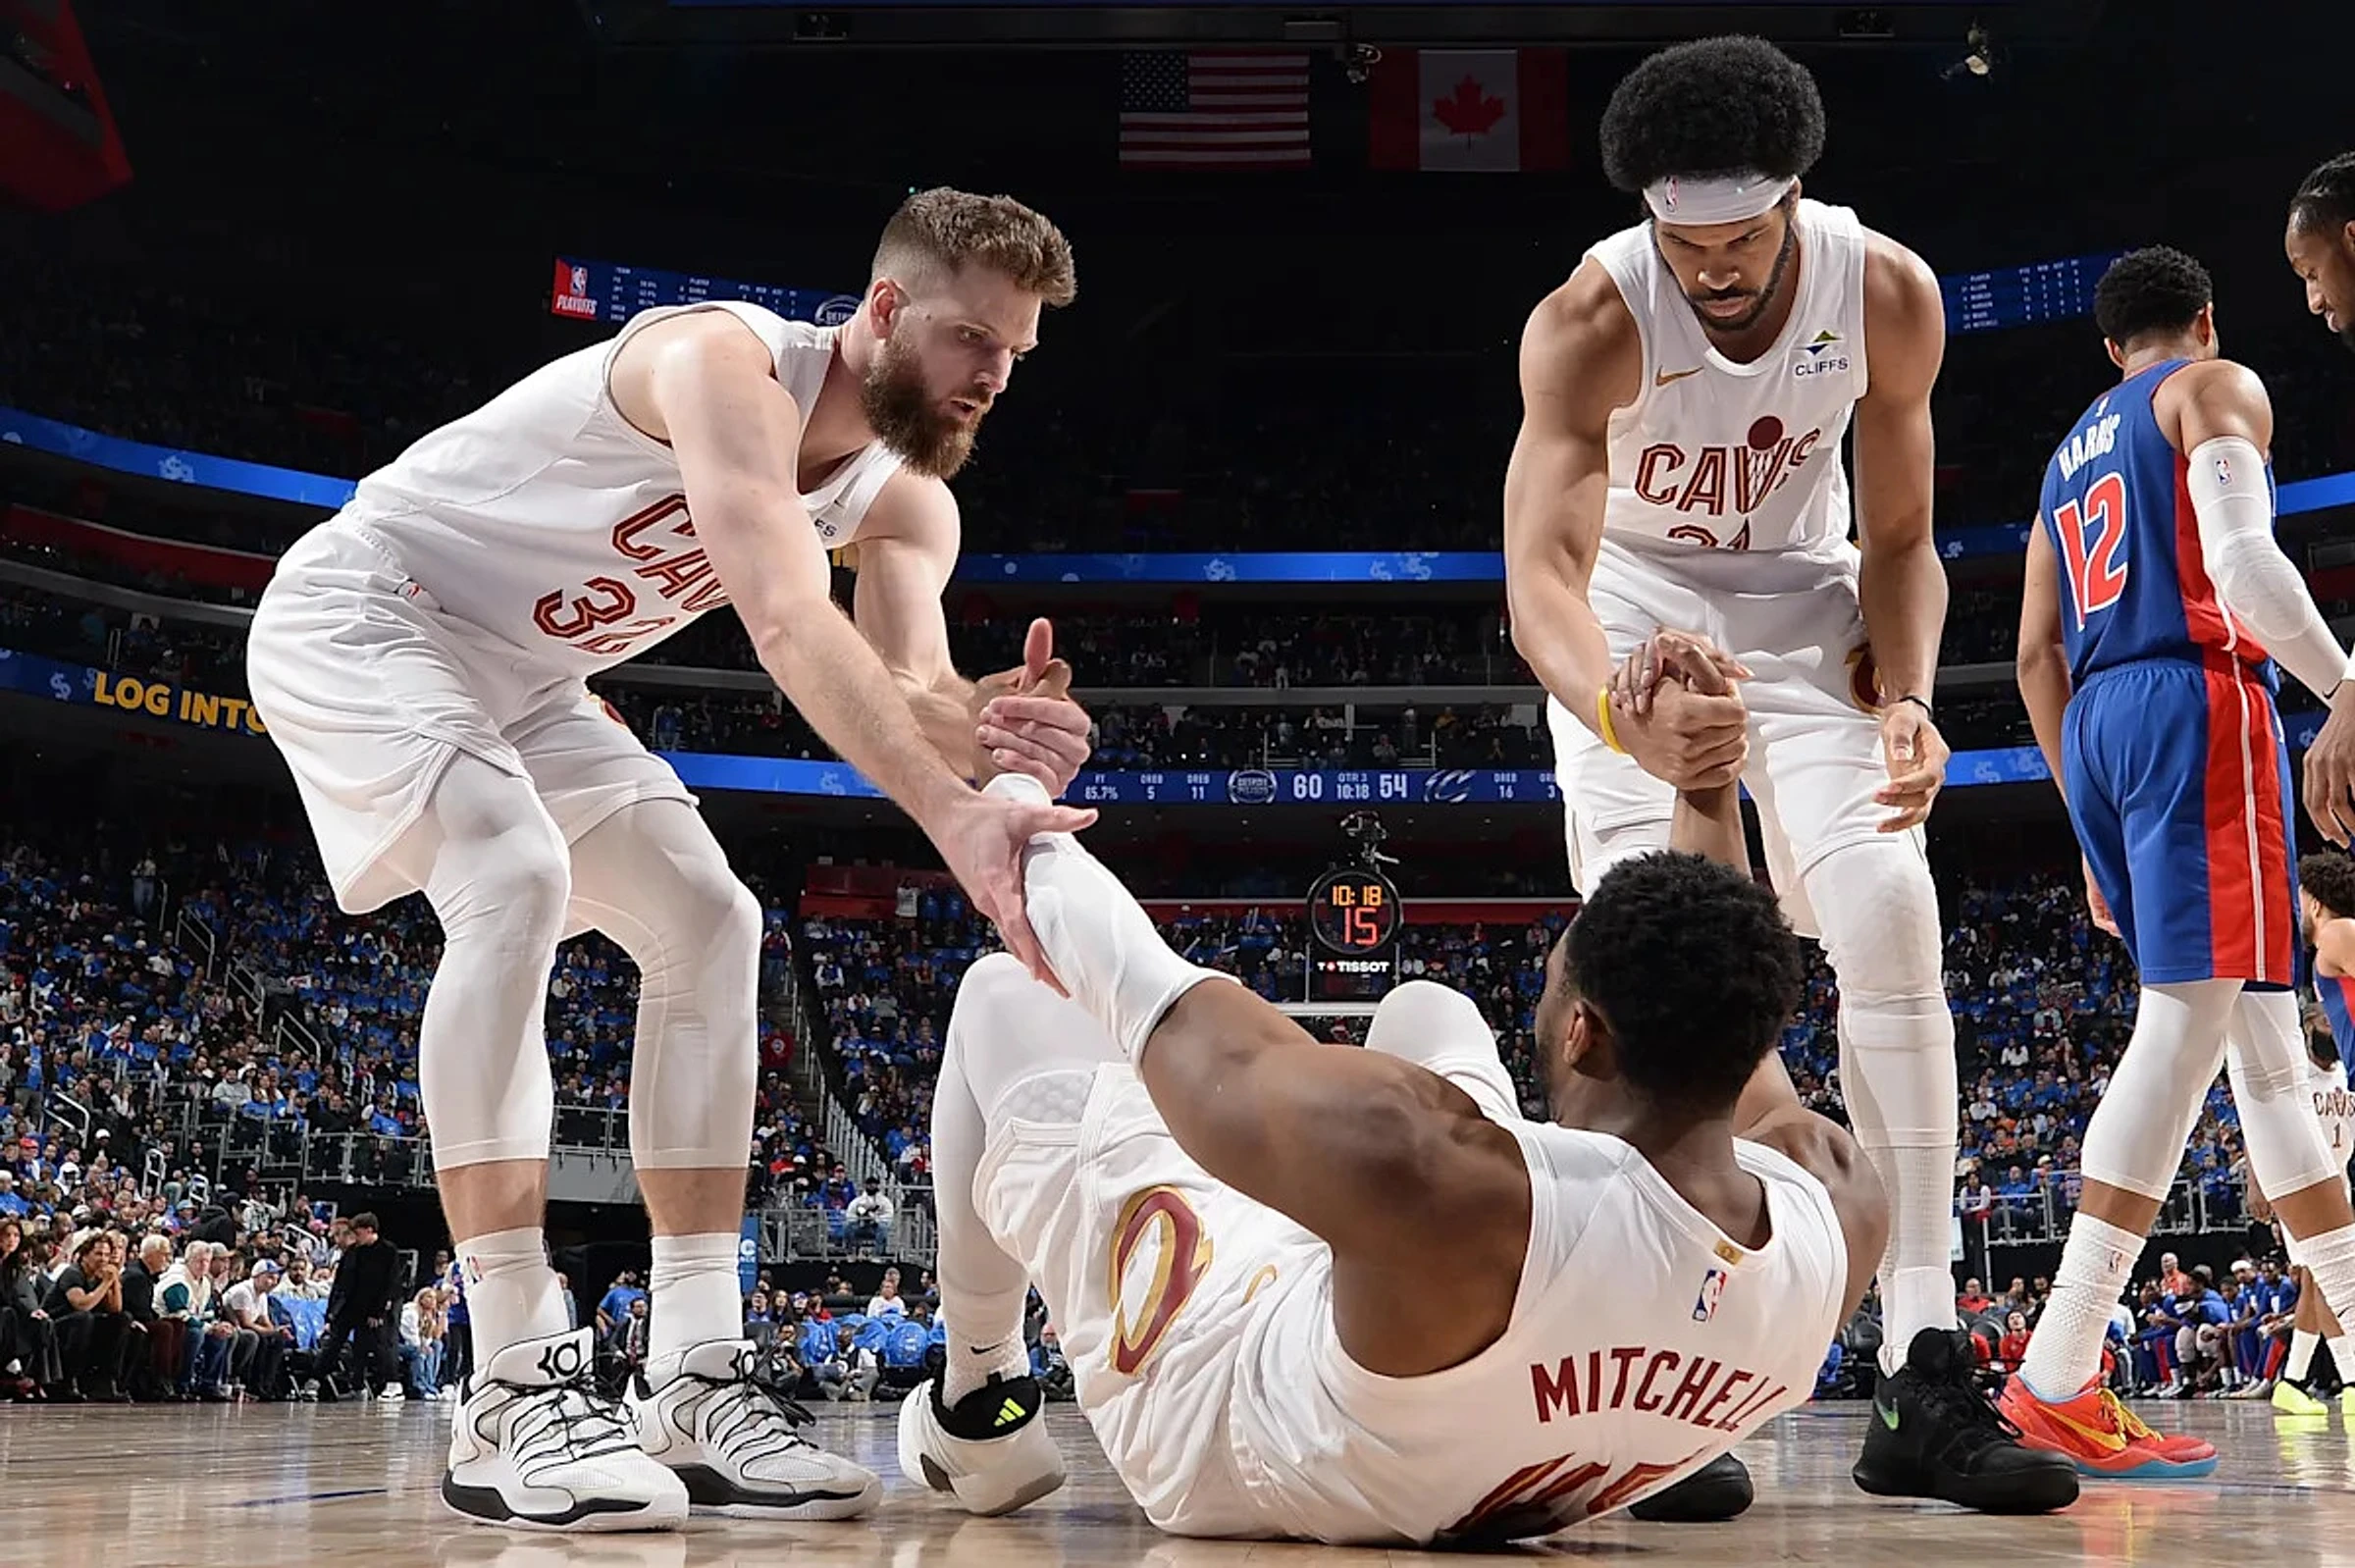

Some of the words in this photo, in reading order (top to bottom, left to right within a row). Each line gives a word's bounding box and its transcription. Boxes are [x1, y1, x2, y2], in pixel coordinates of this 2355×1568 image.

[556, 295, 598, 315] PLAYOFFS
[1795, 357, 1849, 377] CLIFFS
[1635, 428, 1820, 516] CAVS
[611, 493, 731, 613] CAV
[2053, 472, 2128, 633] 12
[94, 671, 171, 716] LOG
[1146, 786, 1155, 800] 5
[1191, 786, 1205, 800] 11
[1293, 774, 1322, 799] 60
[1336, 784, 1370, 800] 10:18
[1380, 773, 1408, 799] 54
[1499, 785, 1514, 799] 16
[1332, 885, 1382, 906] 10:18
[1344, 908, 1378, 945] 15
[1336, 962, 1389, 972] TISSOT
[2331, 1123, 2341, 1148] 1
[1530, 1346, 1787, 1433] MITCHELL
